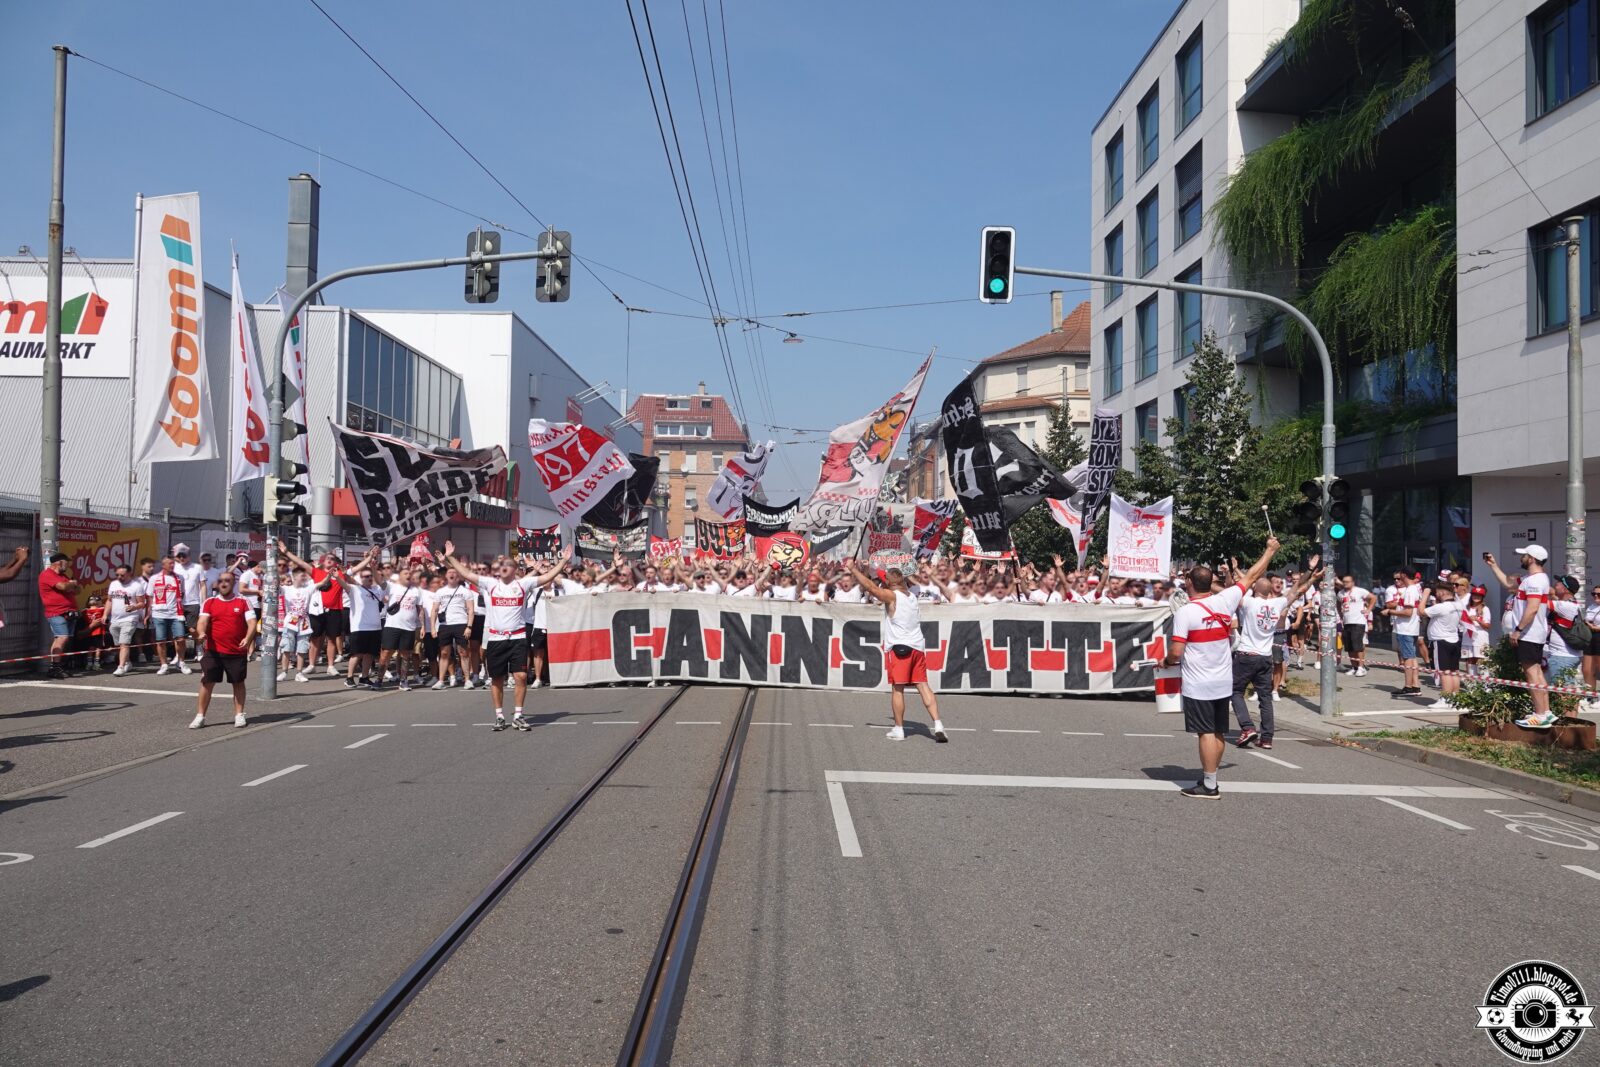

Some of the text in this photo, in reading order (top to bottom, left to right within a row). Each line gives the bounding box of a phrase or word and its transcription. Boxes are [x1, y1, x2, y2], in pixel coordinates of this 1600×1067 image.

[158, 267, 201, 449] toom
[87, 522, 118, 530] reduzierte
[94, 541, 138, 583] SSV
[495, 597, 519, 606] debitel
